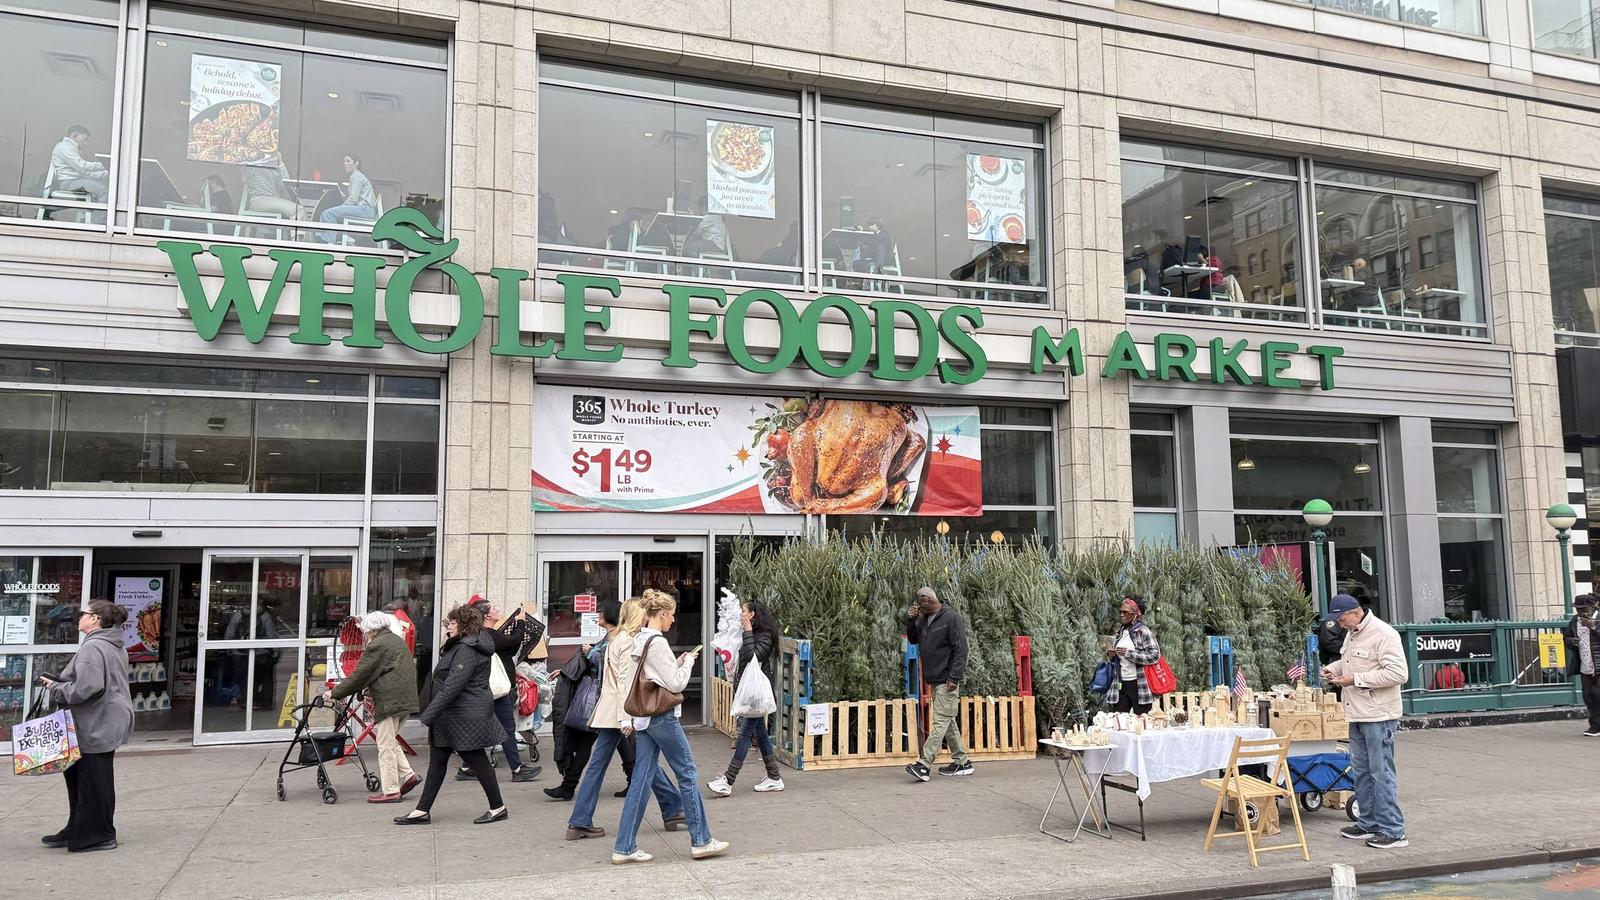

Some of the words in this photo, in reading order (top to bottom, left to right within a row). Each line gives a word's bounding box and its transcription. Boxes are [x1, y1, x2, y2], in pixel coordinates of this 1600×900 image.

[217, 79, 256, 89] sesame's
[202, 85, 234, 97] holiday
[236, 89, 264, 100] debut.
[712, 183, 739, 193] Mashed
[720, 192, 734, 201] just
[157, 206, 624, 363] WHOLE
[661, 284, 988, 385] FOODS
[1029, 325, 1345, 391] MARKET
[576, 399, 602, 415] 365
[609, 398, 661, 414] Whole
[663, 401, 721, 420] Turkey
[611, 414, 626, 425] No
[627, 416, 686, 427] antibiotics,
[687, 419, 712, 428] ever.
[572, 433, 612, 441] STARTING
[617, 474, 632, 485] LB
[634, 486, 655, 494] Prime
[1258, 526, 1306, 541] Grocery
[1416, 636, 1462, 652] Subway
[24, 719, 60, 738] Buffalo
[18, 729, 64, 751] Exchange
